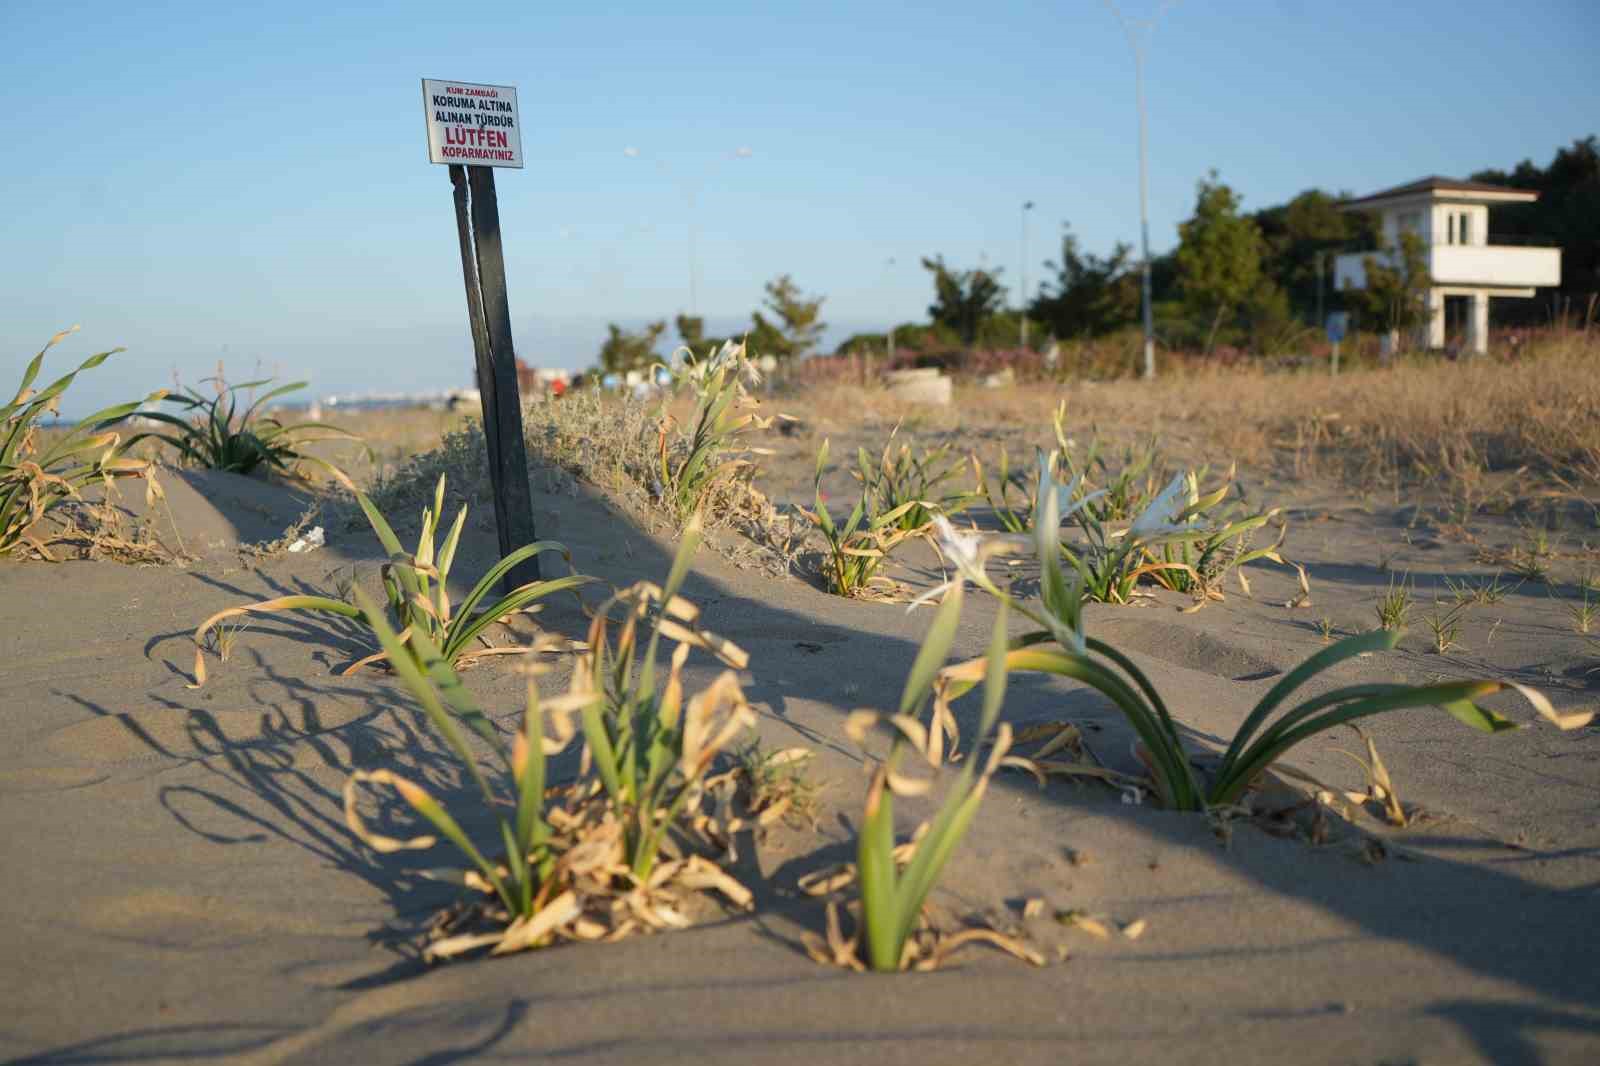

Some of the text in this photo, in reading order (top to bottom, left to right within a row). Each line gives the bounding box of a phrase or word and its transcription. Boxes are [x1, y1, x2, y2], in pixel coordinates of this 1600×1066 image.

[432, 95, 513, 112] KORUMA ALTINA
[435, 111, 514, 128] ALINAN TÜRDÜR
[445, 124, 508, 148] LÜTFEN
[441, 146, 514, 161] KOPARMAYINIZ
